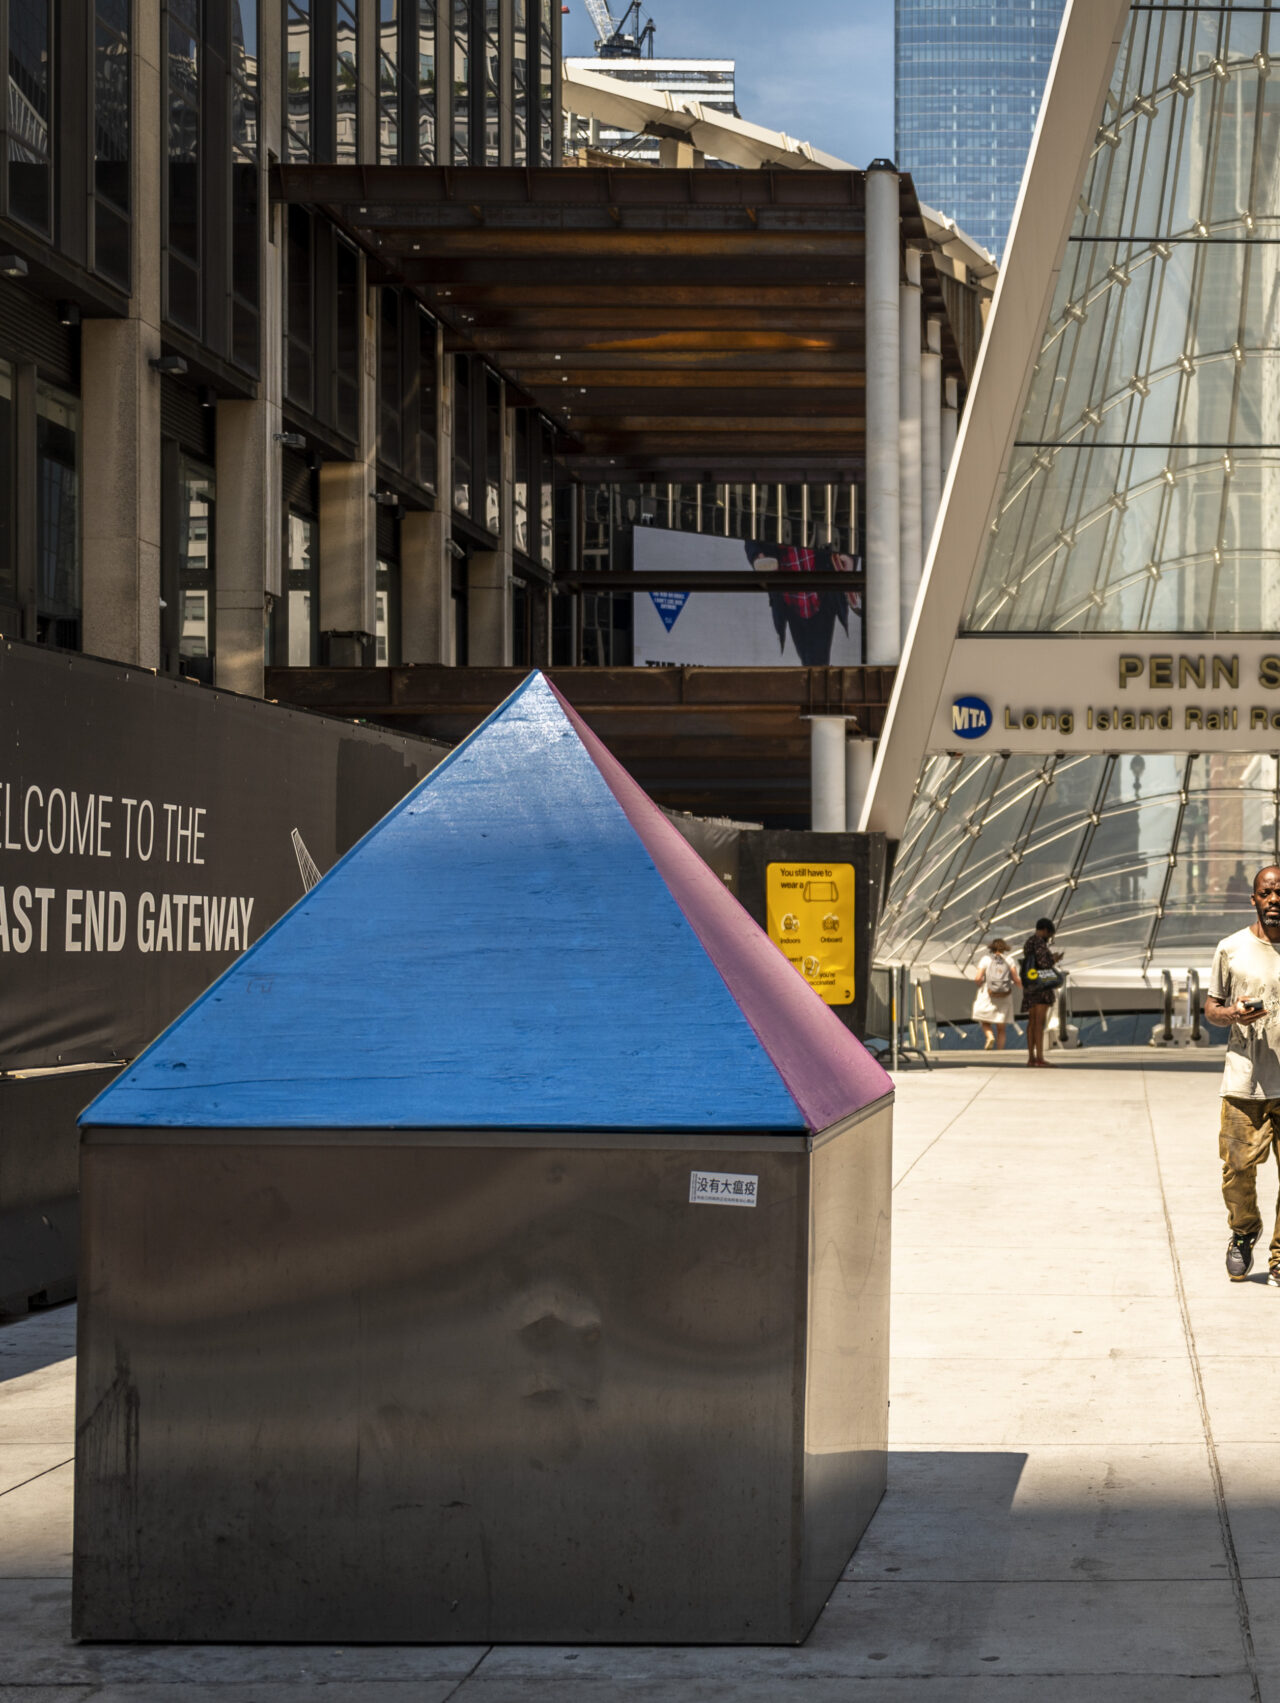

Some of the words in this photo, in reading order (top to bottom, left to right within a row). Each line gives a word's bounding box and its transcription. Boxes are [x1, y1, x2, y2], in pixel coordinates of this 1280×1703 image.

[1118, 654, 1240, 690] PENN
[951, 705, 987, 731] MTA
[1003, 706, 1075, 735] Long
[1086, 706, 1173, 731] Island
[1184, 706, 1239, 731] Rail
[0, 782, 113, 858] LCOME
[122, 798, 155, 862] TO
[163, 803, 207, 864] THE
[780, 868, 794, 877] You
[795, 868, 806, 877] still
[807, 868, 825, 877] have
[825, 869, 832, 877] to
[65, 888, 127, 952] END
[137, 890, 254, 953] GATEWAY
[696, 1177, 756, 1196] 没有大瘟疫
